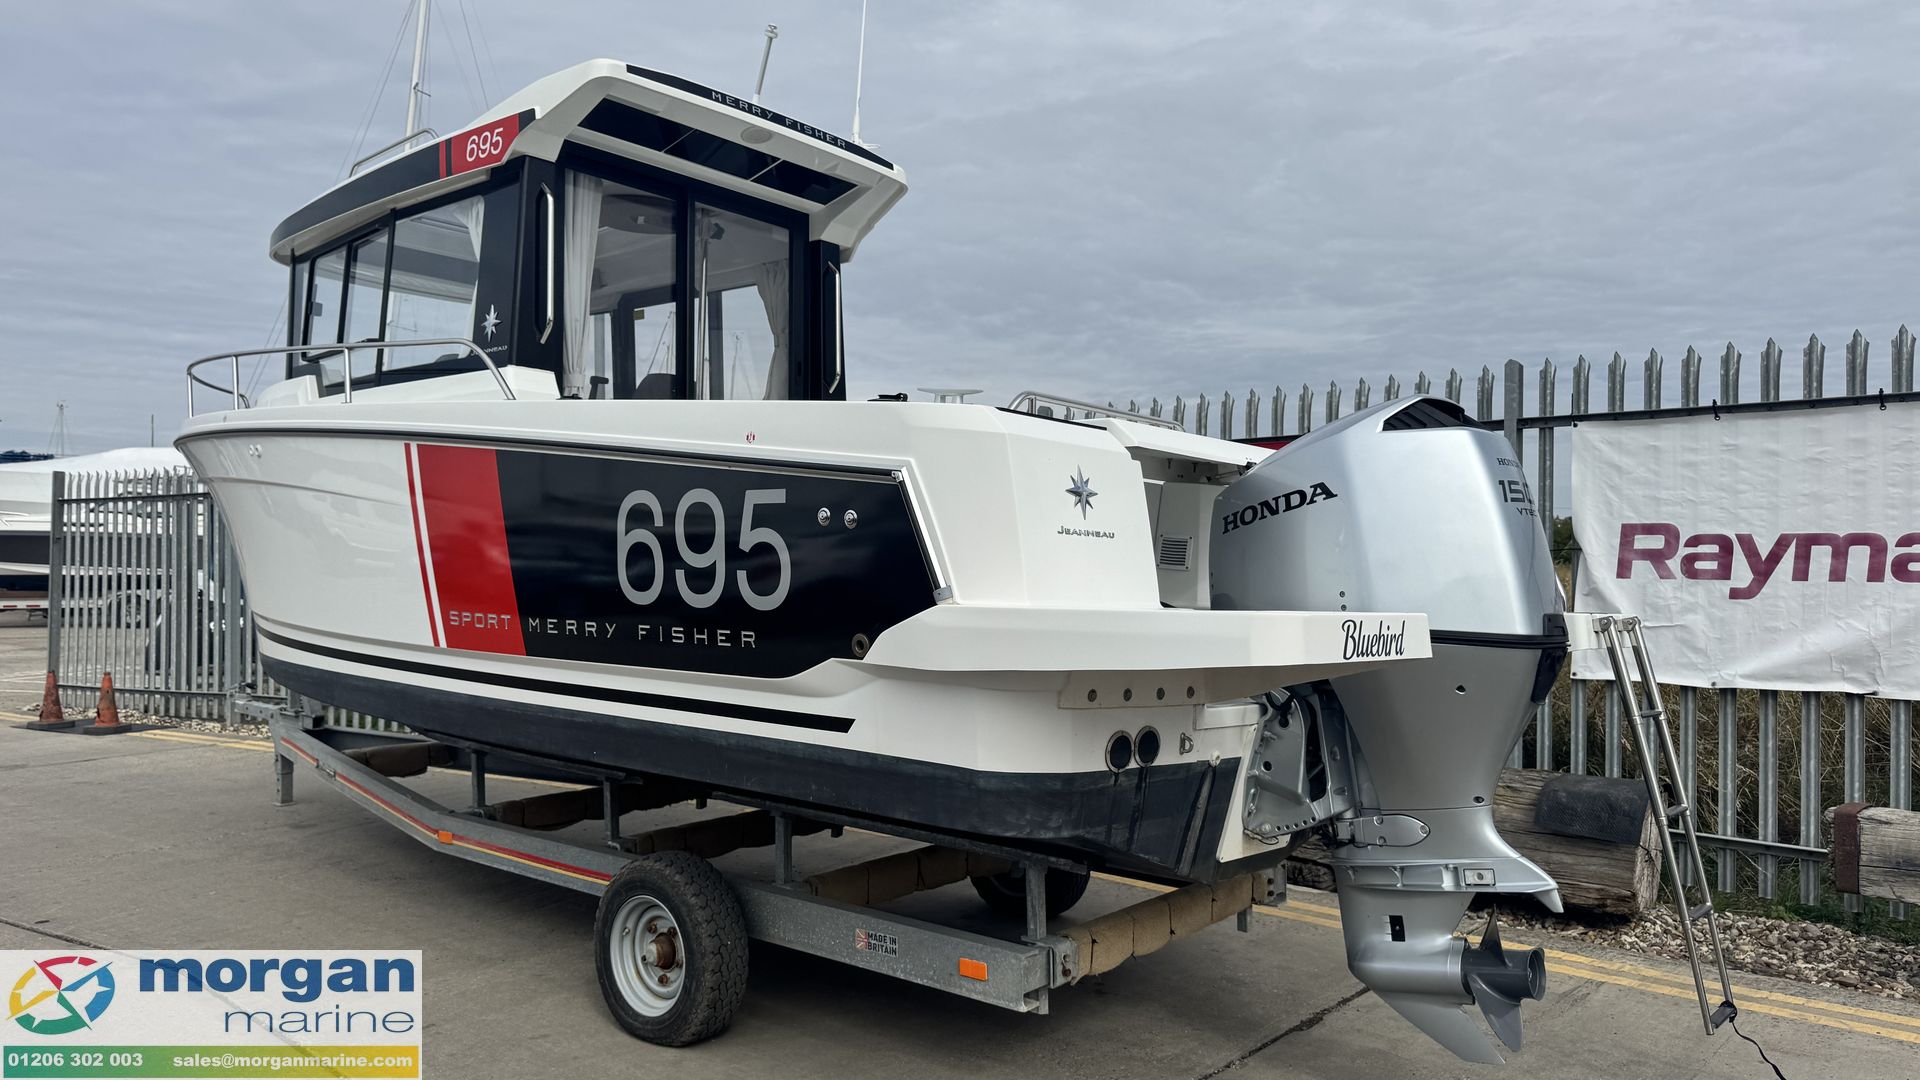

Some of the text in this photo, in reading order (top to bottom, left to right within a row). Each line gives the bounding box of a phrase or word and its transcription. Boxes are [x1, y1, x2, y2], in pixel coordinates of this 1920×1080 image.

[712, 91, 846, 149] MERRY FISHER
[466, 128, 504, 162] 695
[1222, 482, 1338, 534] HONDA
[617, 488, 791, 611] 695
[450, 611, 757, 649] SPORT MERRY FISHER
[1342, 619, 1406, 660] Bluebird
[867, 932, 897, 946] MADE IN
[867, 942, 897, 956] BRITAIN
